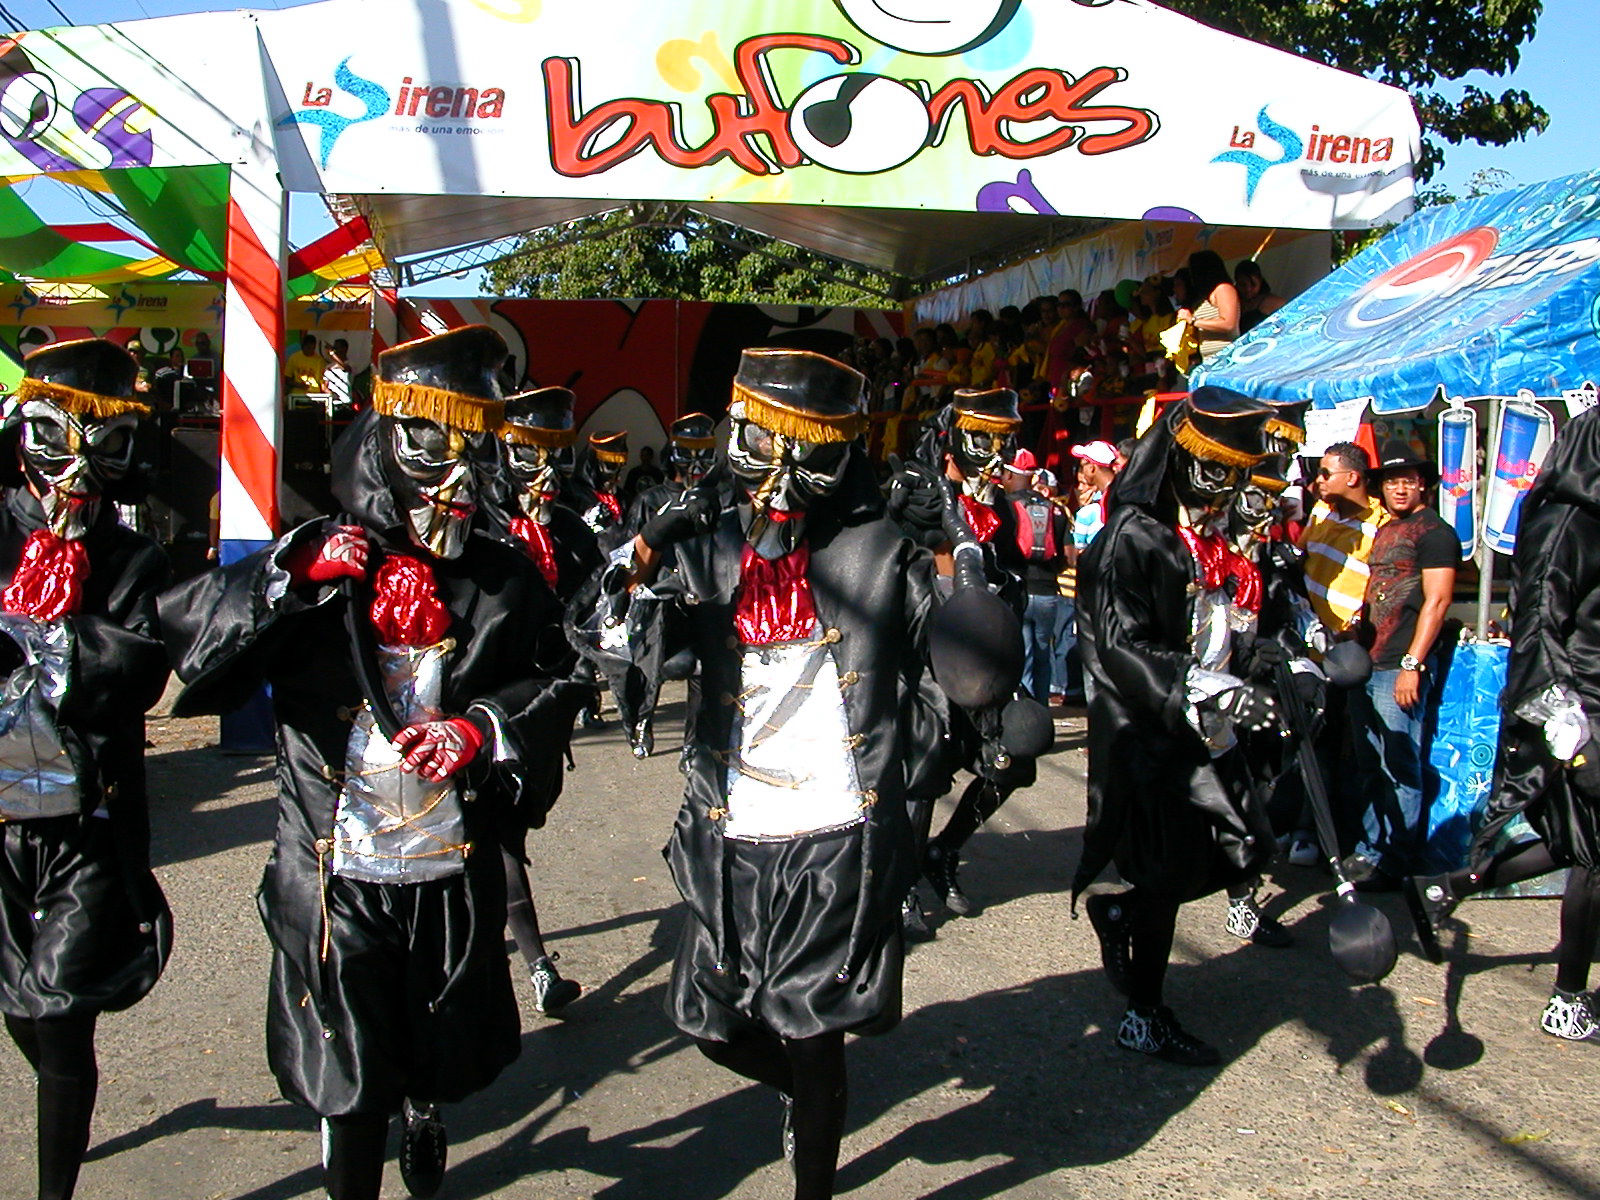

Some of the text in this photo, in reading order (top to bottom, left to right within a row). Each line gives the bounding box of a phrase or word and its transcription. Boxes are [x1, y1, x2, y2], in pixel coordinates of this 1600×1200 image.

[301, 81, 333, 107] La
[415, 124, 429, 134] de
[432, 126, 453, 135] una
[1229, 125, 1256, 149] La
